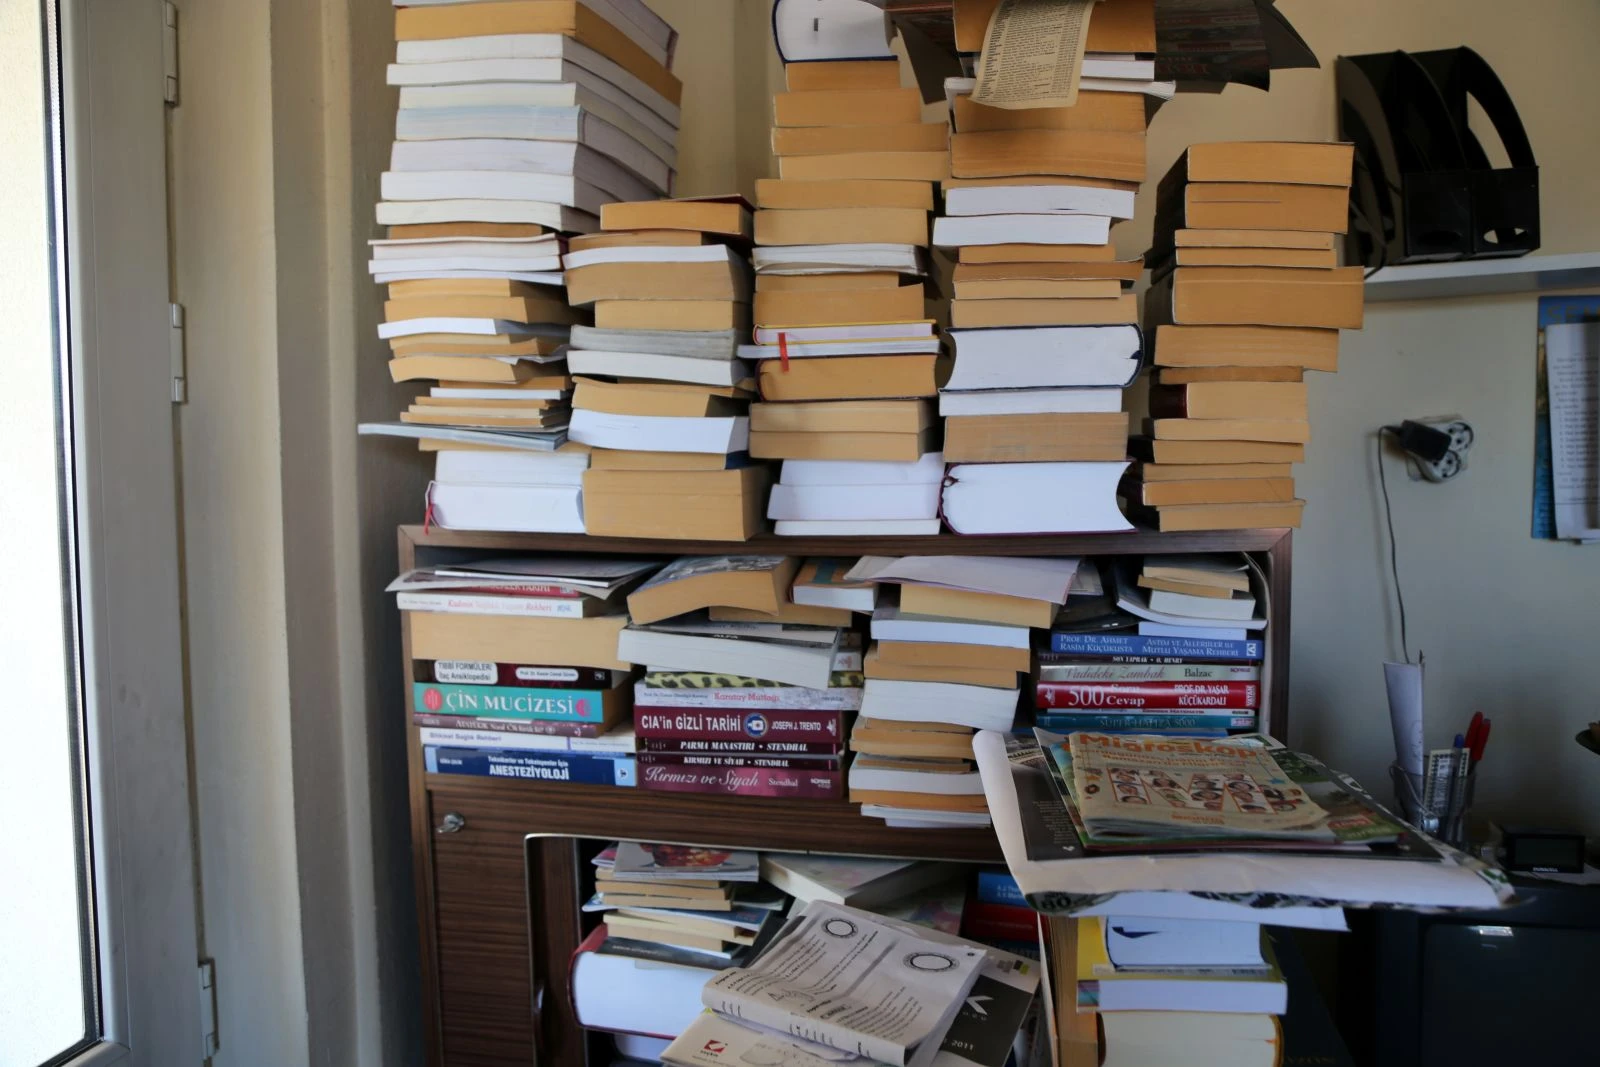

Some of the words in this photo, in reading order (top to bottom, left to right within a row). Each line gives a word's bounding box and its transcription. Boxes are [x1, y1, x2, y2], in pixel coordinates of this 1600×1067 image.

[1100, 635, 1128, 645] AHMET
[1117, 665, 1167, 680] Zambak
[1183, 668, 1213, 678] Balzac
[446, 689, 478, 714] ÇİN
[484, 693, 574, 714] MUCİZESİ
[1068, 686, 1105, 706] 500
[1106, 695, 1146, 708] Cevap
[641, 715, 673, 730] CIA'in
[675, 713, 703, 731] GİZLİ
[706, 714, 741, 732] TARİHİ
[771, 720, 793, 730] JOSEPH
[799, 721, 822, 731] TRENTO
[680, 741, 710, 750] PARMA
[711, 741, 756, 751] MANASTIRI
[766, 742, 808, 752] STENDHAL
[684, 756, 712, 766] KIRMIZI
[713, 757, 723, 765] VE
[723, 756, 745, 766] SİYAH
[754, 758, 789, 768] STENDHAL
[488, 763, 570, 780] ANESTEZİYOLOJİ
[645, 765, 698, 783] Kırmızı
[700, 773, 717, 785] ve
[719, 768, 759, 792] Siyah
[768, 777, 799, 787] Stendhal
[951, 1039, 974, 1051] 2011
